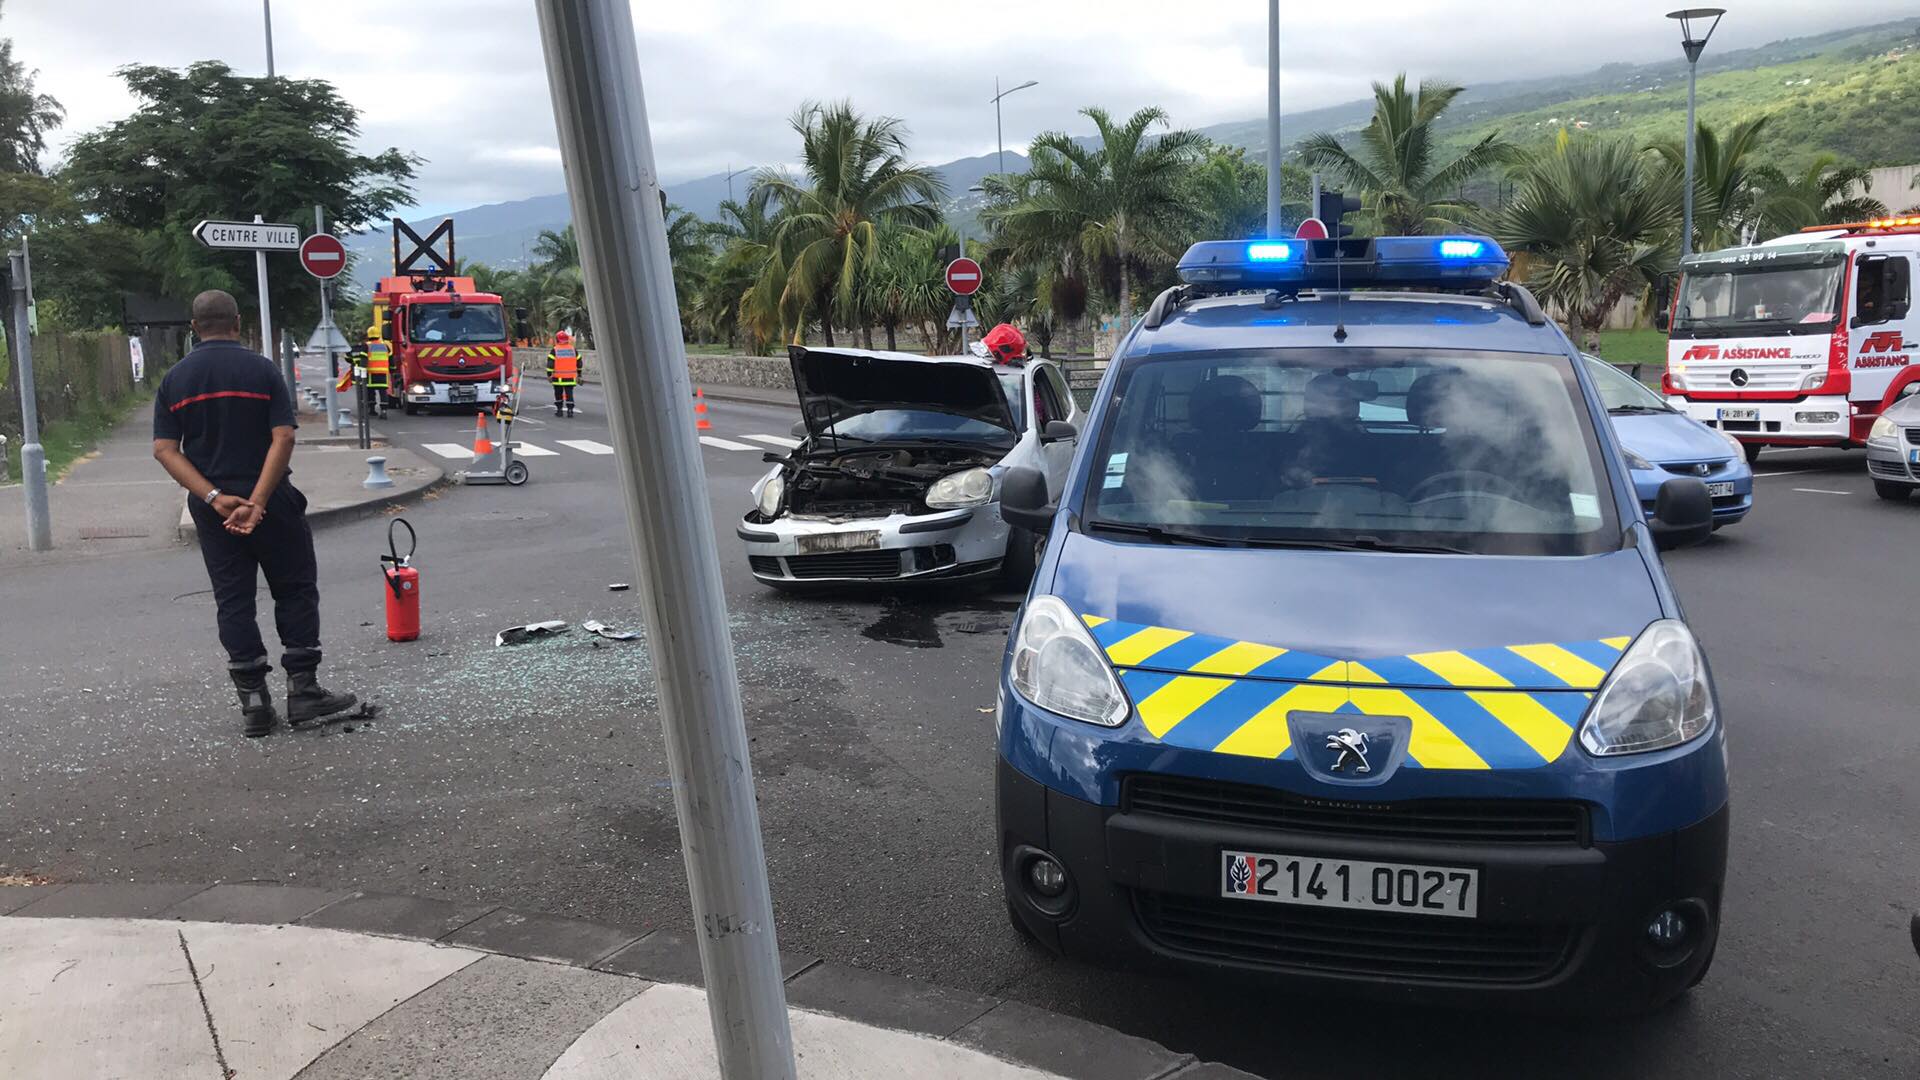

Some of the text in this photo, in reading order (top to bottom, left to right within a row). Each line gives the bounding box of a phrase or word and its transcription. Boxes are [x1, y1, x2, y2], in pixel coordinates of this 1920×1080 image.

[212, 228, 296, 244] CENTRE VILLE
[1739, 254, 1751, 262] 33
[1767, 251, 1777, 260] 14
[1722, 347, 1792, 360] ASSISTANCE
[1854, 355, 1910, 369] ASSISTANCE
[1256, 858, 1472, 911] 2141 0027
